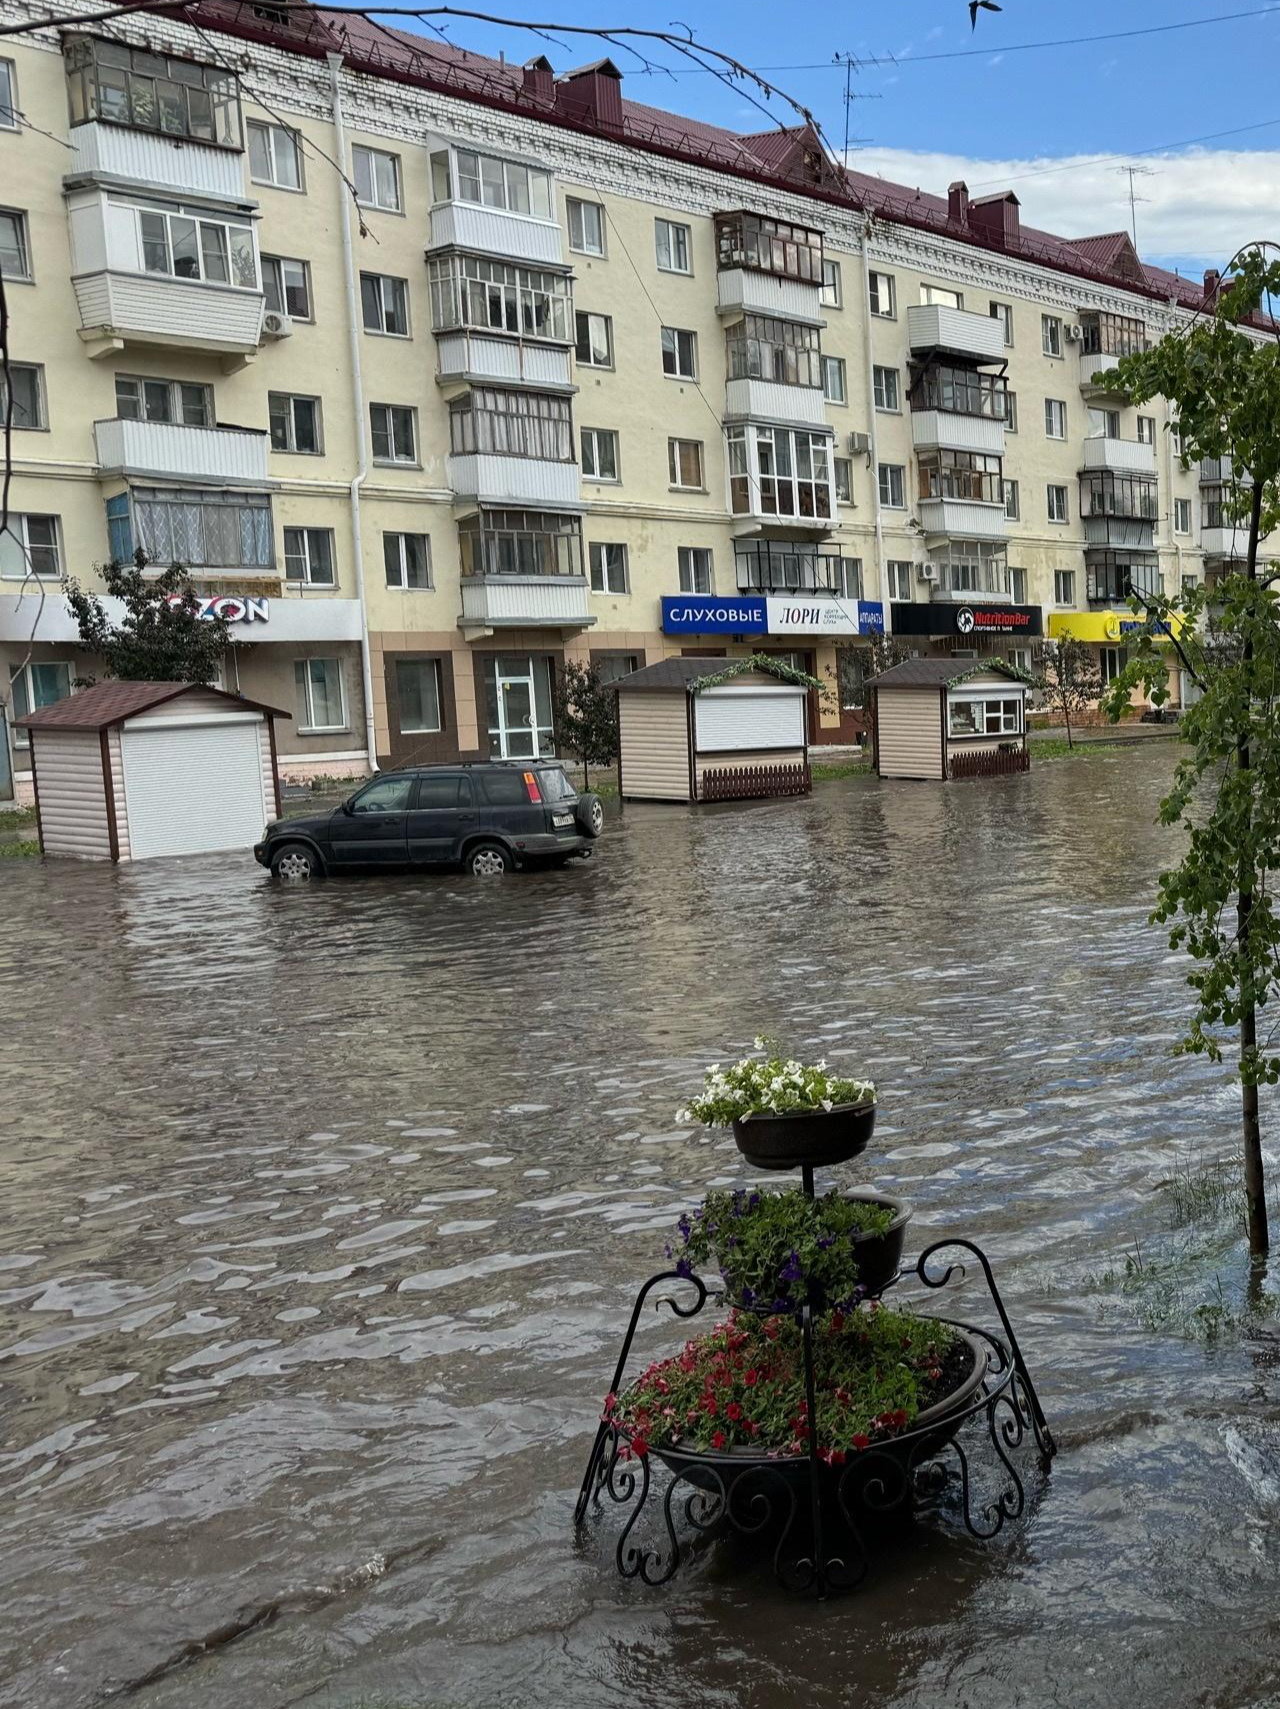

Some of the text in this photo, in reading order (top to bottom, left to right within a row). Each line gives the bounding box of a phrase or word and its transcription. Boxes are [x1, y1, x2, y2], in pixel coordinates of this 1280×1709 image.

[669, 608, 763, 622] СЛУХОВЫЕ
[780, 607, 821, 625] ЛОРИ
[859, 612, 883, 625] АППАРАТЫ
[974, 611, 1031, 625] NutritionBar
